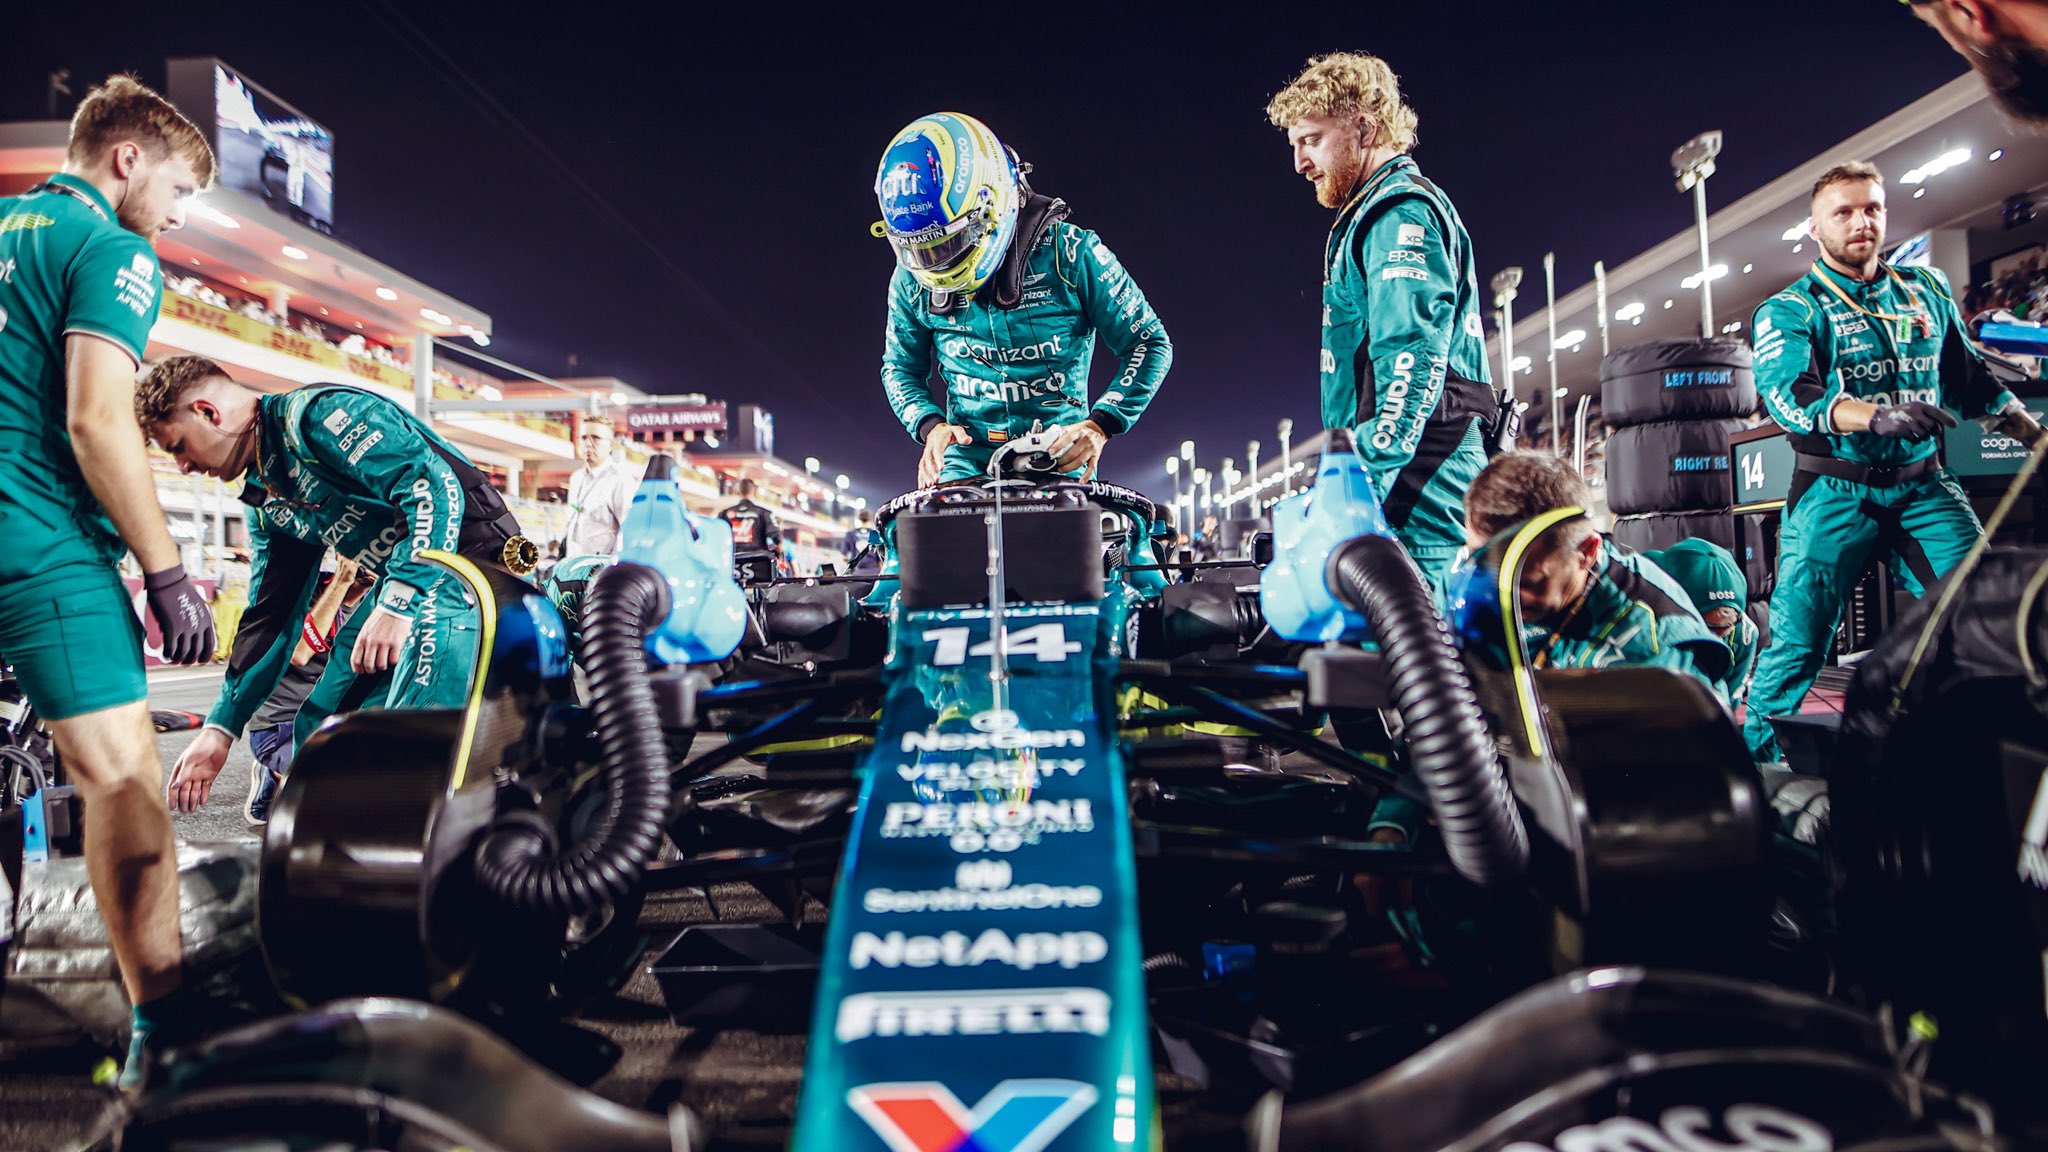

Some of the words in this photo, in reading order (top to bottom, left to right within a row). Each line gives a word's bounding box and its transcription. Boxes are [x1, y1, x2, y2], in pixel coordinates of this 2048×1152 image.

[954, 137, 970, 194] aramco
[910, 201, 934, 214] Bank
[909, 230, 944, 245] MARTIN
[1388, 250, 1426, 265] EPOS
[174, 300, 229, 332] DHL
[270, 330, 315, 359] DHL
[945, 334, 1063, 364] cognizant
[1119, 343, 1148, 387] amco
[1665, 372, 1693, 387] LEFT
[1698, 369, 1732, 385] FRONT
[956, 372, 1066, 402] aramco
[1371, 351, 1416, 450] aramco
[629, 412, 669, 427] QATAR
[671, 410, 720, 425] AIRWAYS
[338, 422, 368, 452] EPOS
[1674, 457, 1710, 471] RIGHT
[1715, 455, 1728, 469] RE
[1741, 451, 1765, 490] 14
[318, 504, 367, 548] izant
[442, 470, 461, 553] ognizant
[353, 527, 399, 570] mco
[1709, 591, 1735, 601] BOSS
[415, 628, 437, 687] ASTON
[922, 623, 1083, 667] 14
[901, 728, 1086, 753] NexGen
[884, 799, 1094, 830] PERONI
[864, 883, 1103, 914] SentinelOne
[849, 928, 1108, 970] NetApp
[835, 987, 1111, 1044] PIRELLI
